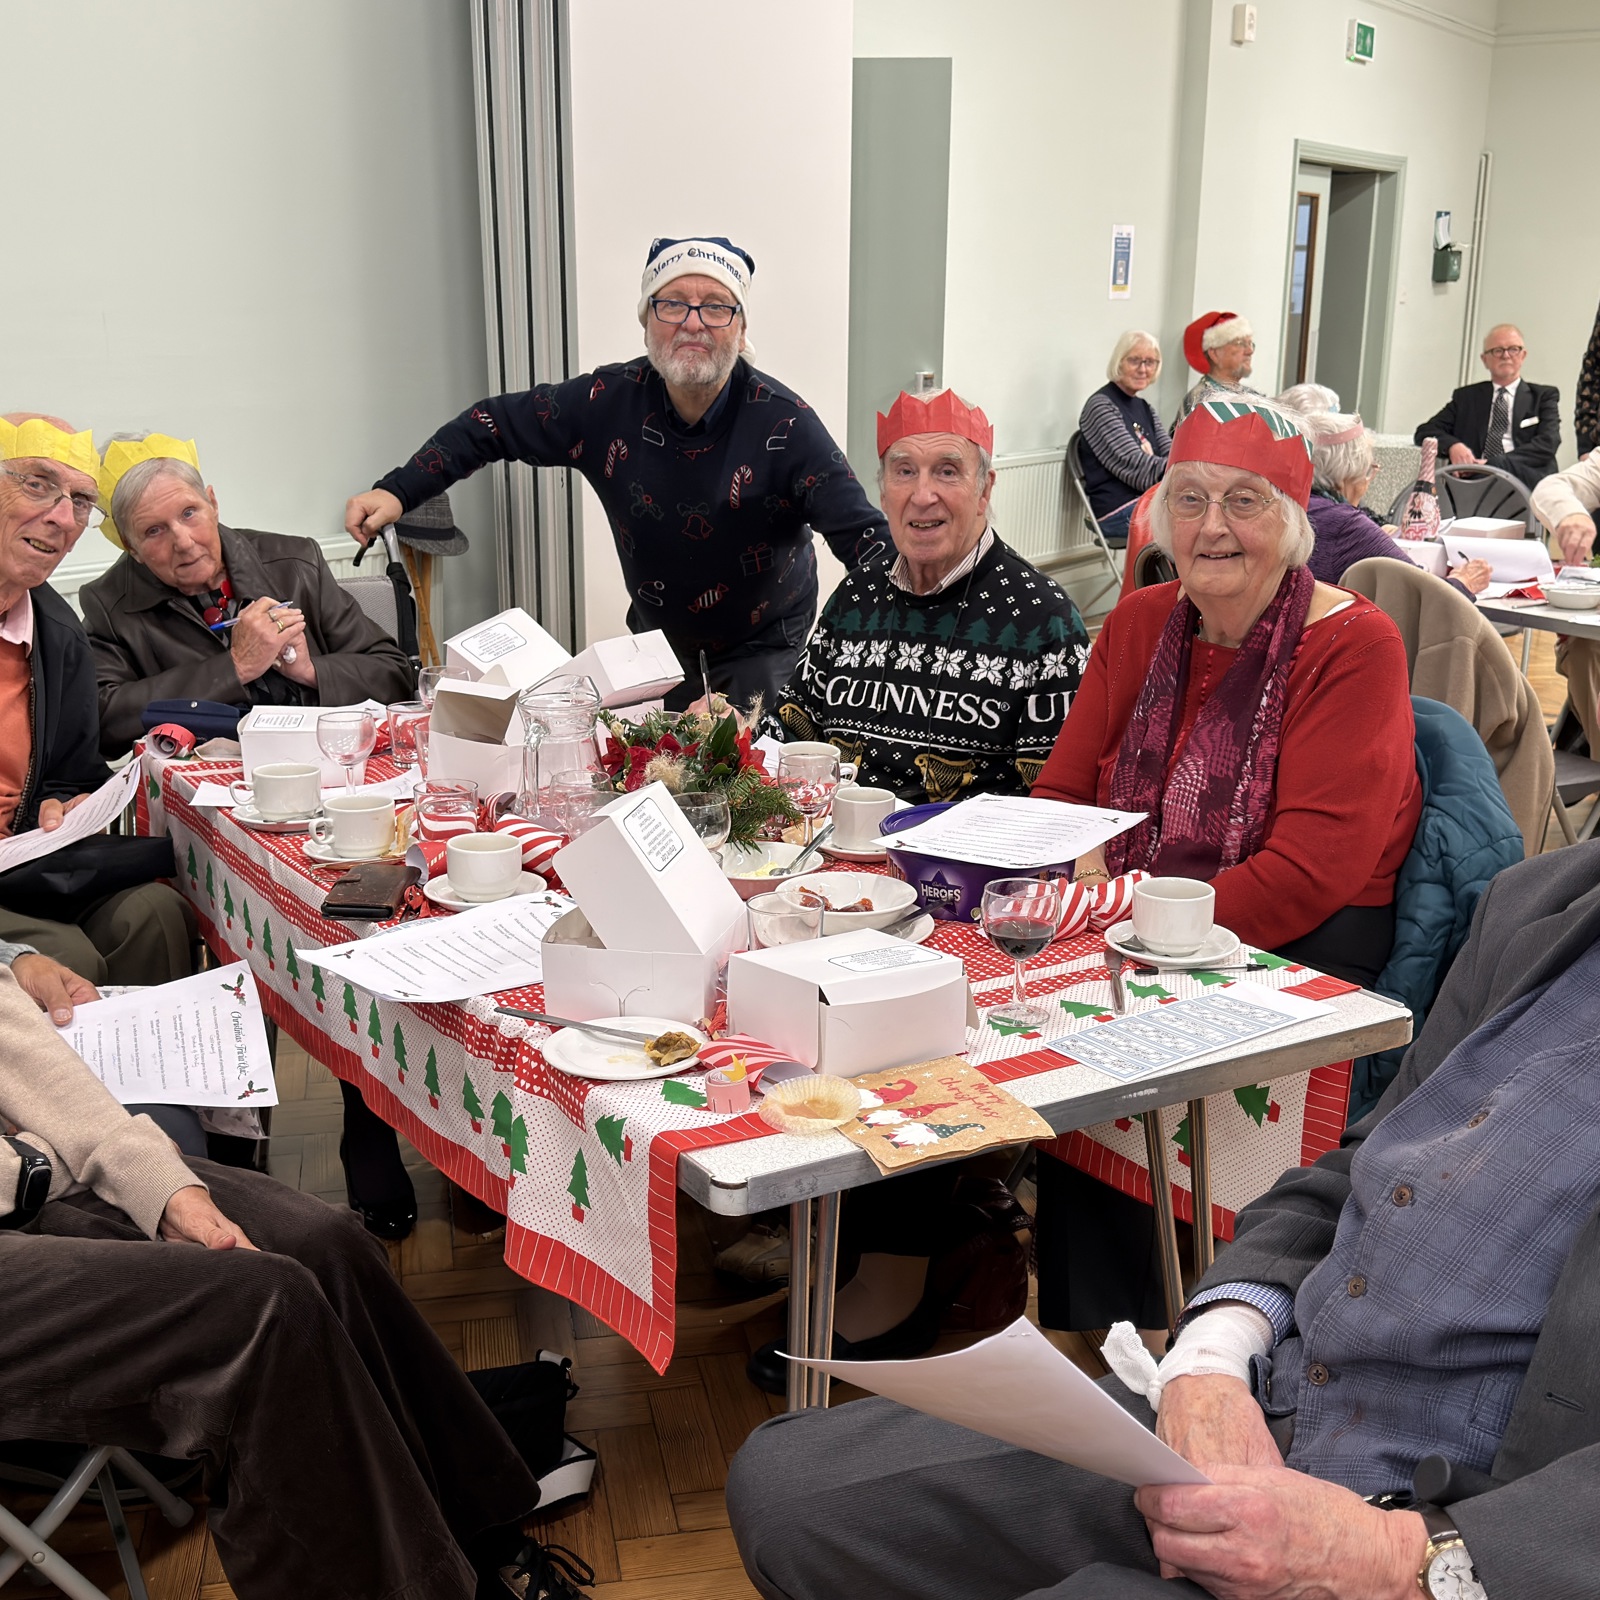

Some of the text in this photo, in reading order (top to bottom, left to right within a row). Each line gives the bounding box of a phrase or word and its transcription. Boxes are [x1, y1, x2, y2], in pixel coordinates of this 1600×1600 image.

[653, 247, 742, 283] Merry Christmas
[920, 883, 962, 902] HEROES
[230, 1010, 246, 1043] Christmas
[237, 1061, 250, 1081] Quiz
